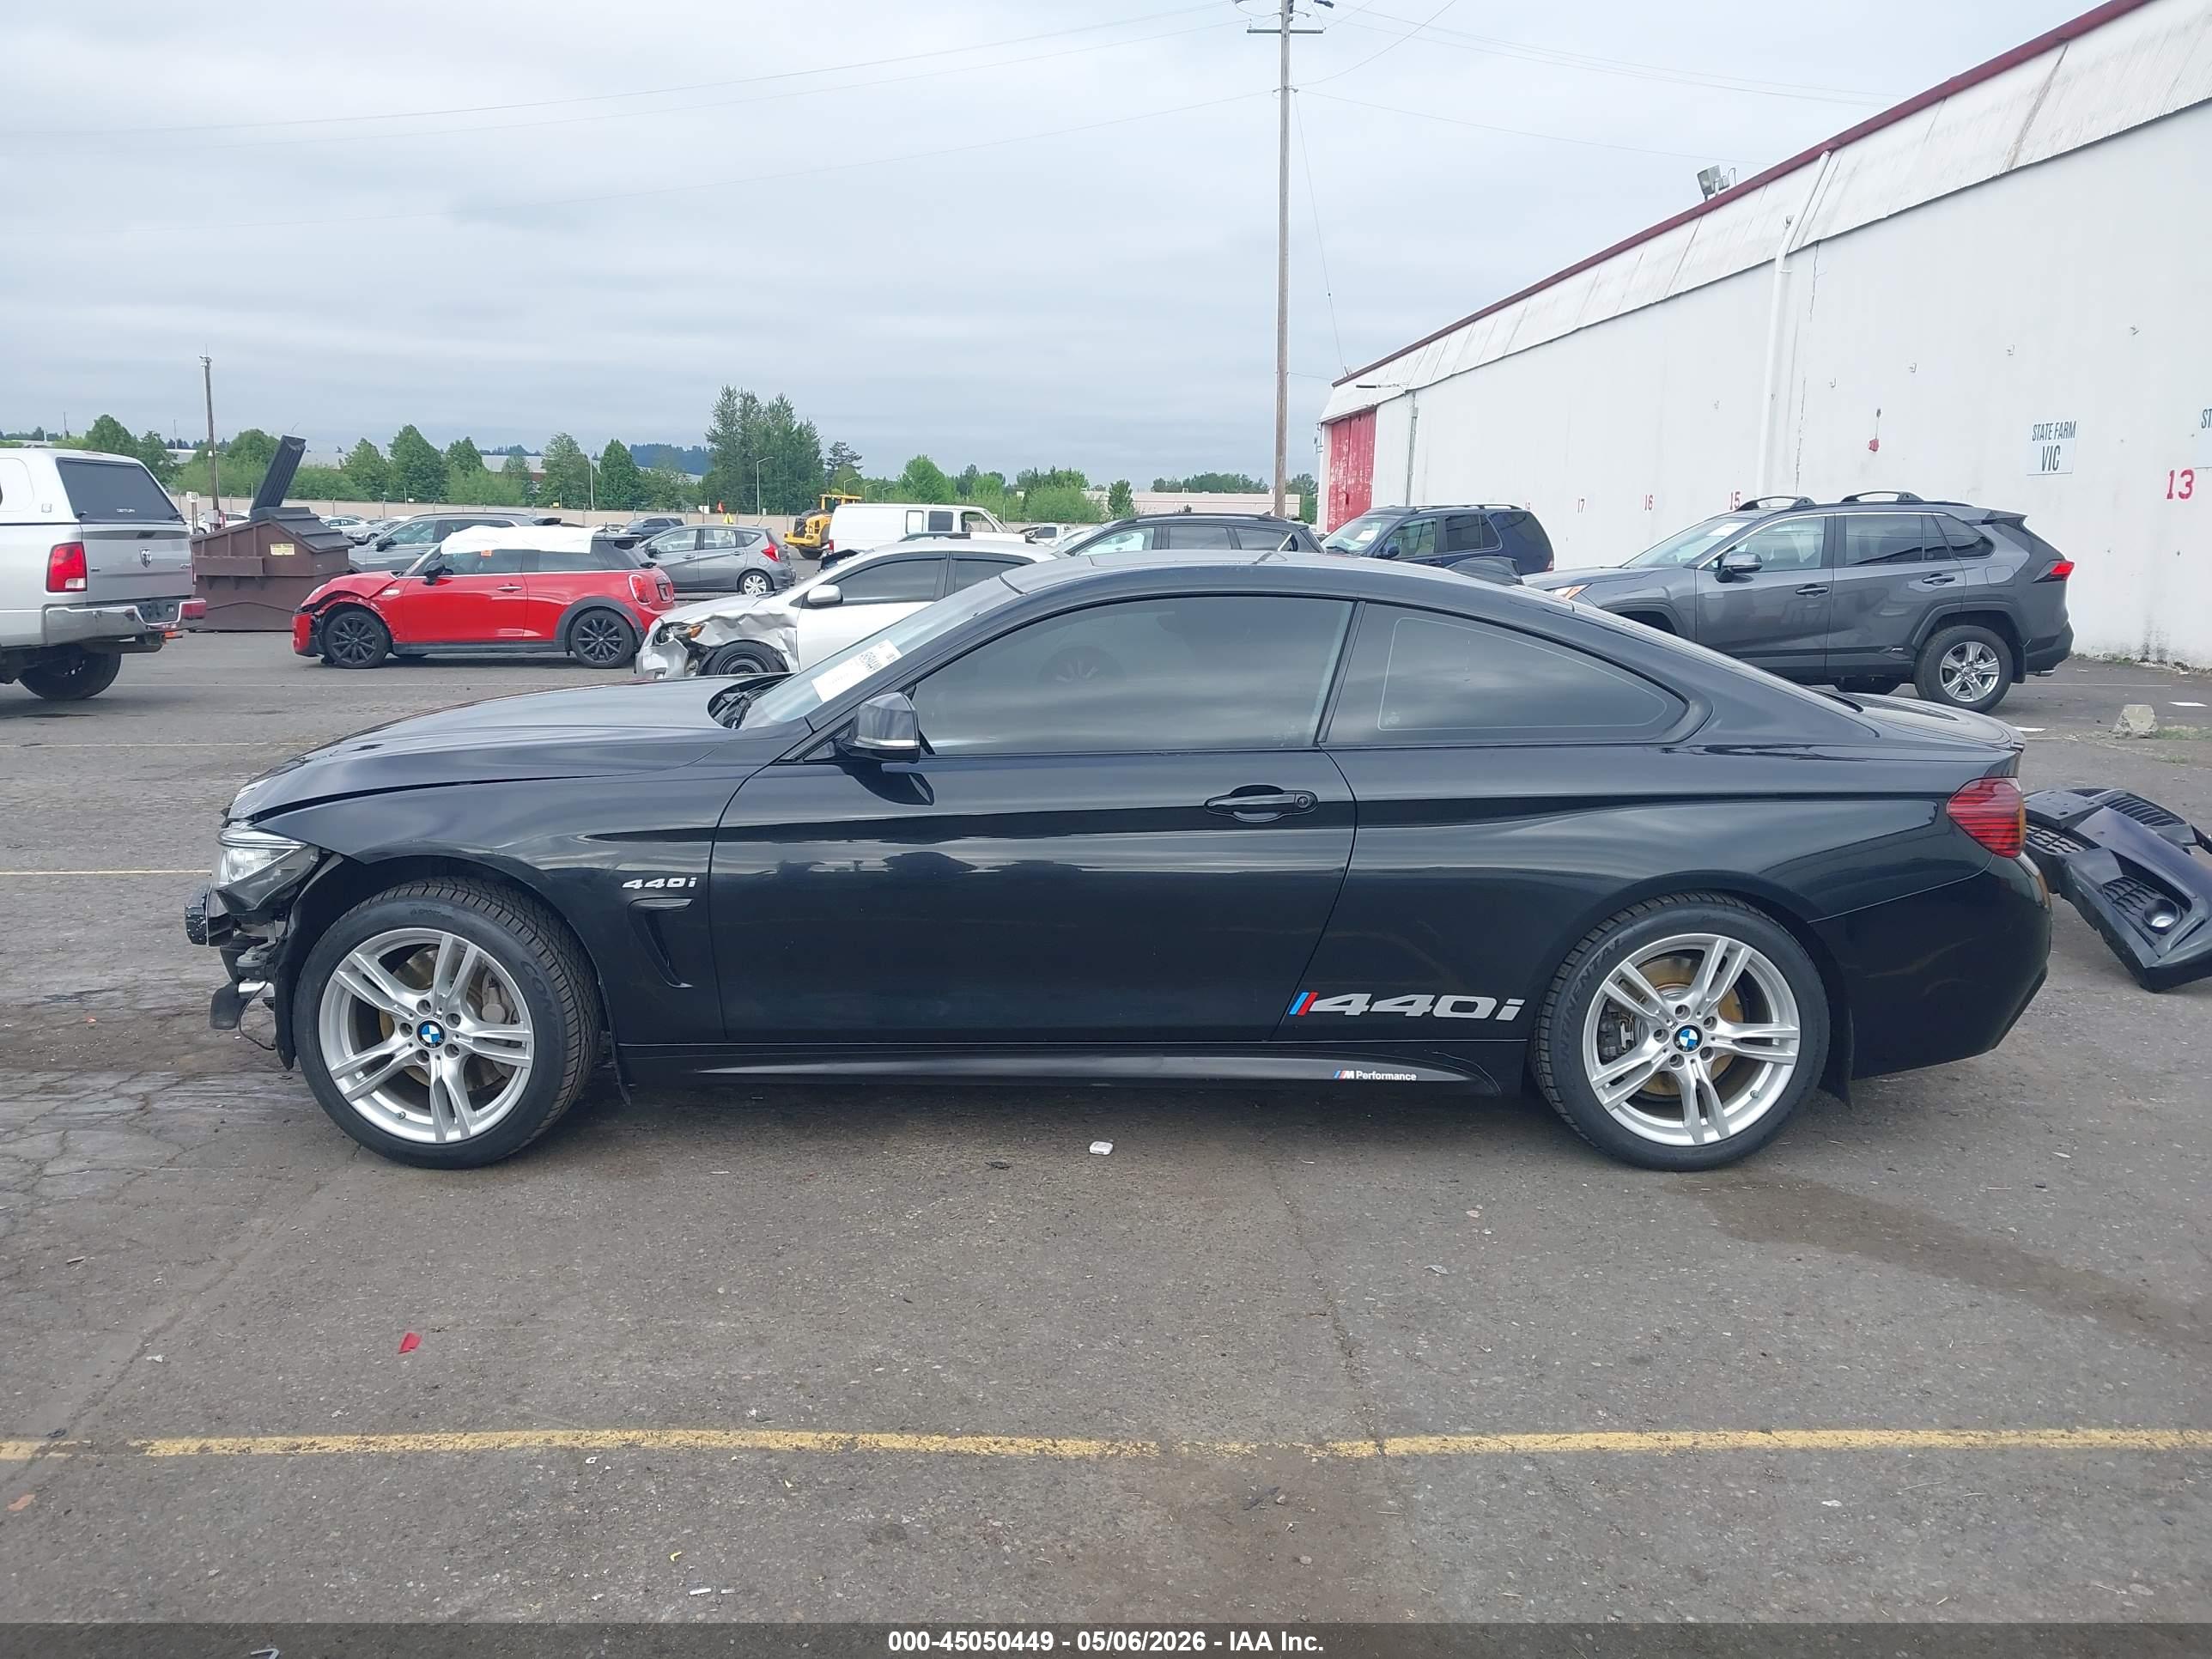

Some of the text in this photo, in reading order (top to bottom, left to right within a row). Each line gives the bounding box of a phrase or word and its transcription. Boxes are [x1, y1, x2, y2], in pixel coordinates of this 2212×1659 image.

[2032, 421, 2077, 441] STATE FARM
[2041, 445, 2061, 471] VIC
[2166, 469, 2195, 500] 13
[1577, 498, 1585, 514] 17
[1644, 494, 1654, 511] 16
[1729, 491, 1741, 510] 15
[622, 877, 697, 890] 440i
[1309, 993, 1526, 1022] 440i
[1356, 1070, 1417, 1081] Performance
